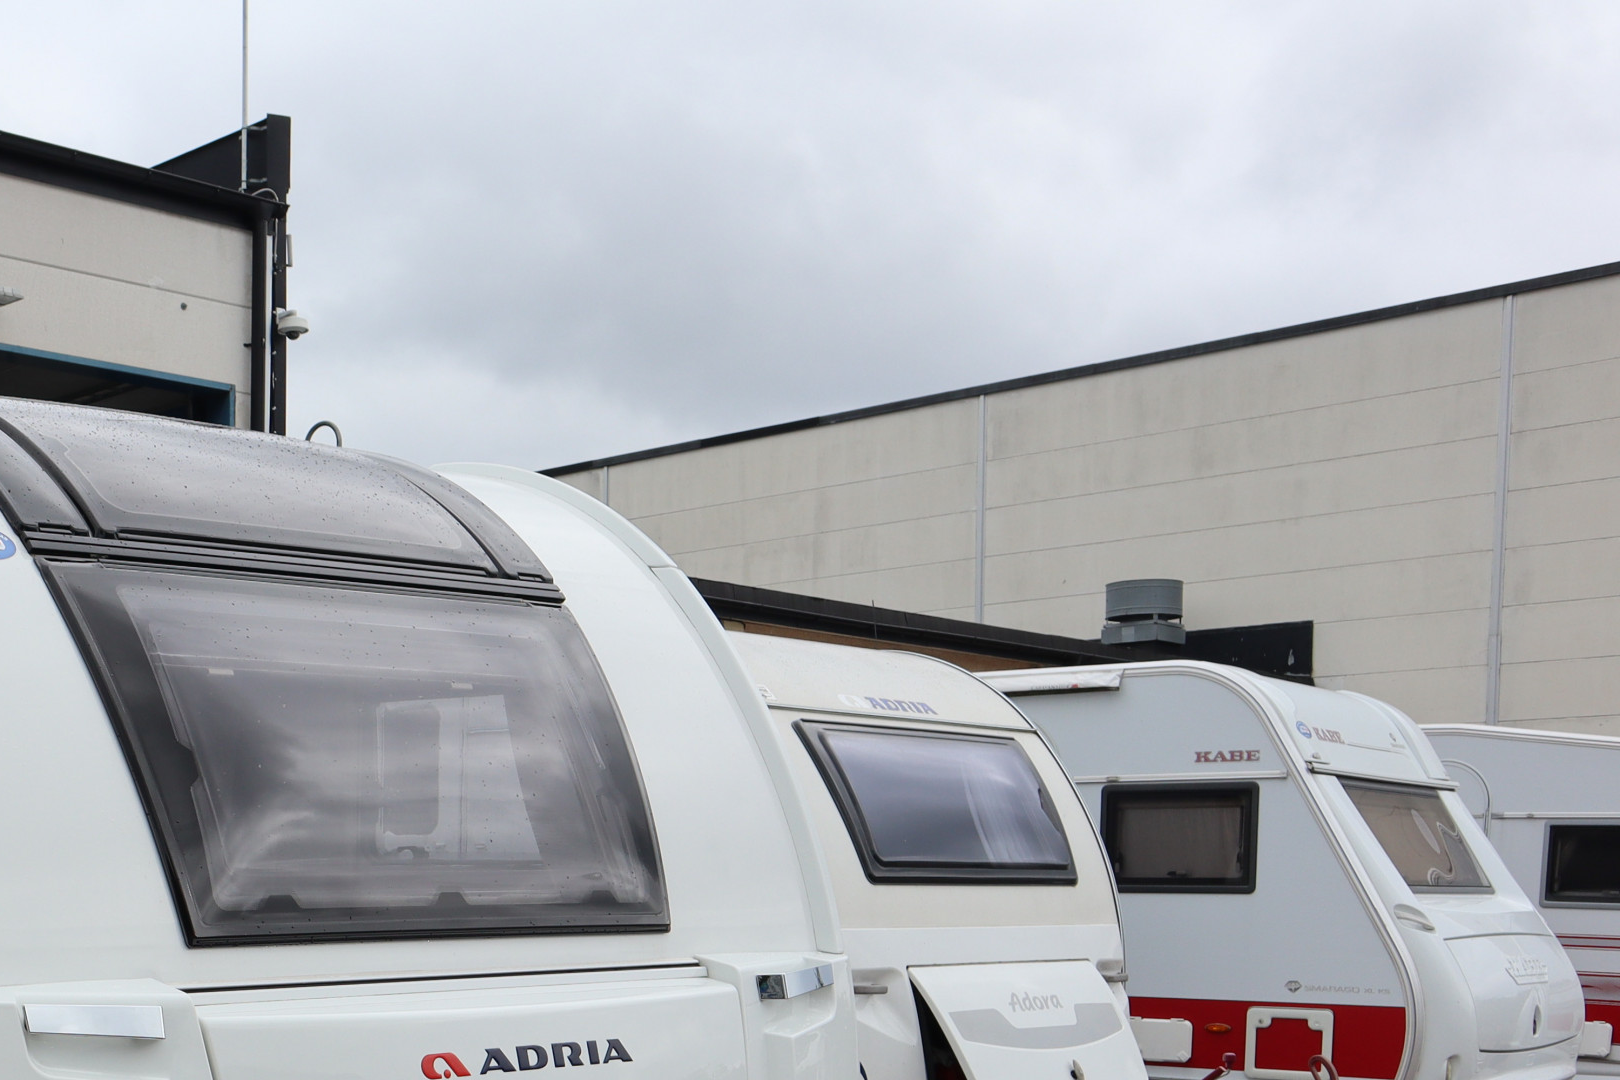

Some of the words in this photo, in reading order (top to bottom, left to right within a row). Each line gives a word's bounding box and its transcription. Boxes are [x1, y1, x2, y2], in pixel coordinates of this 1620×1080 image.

[864, 696, 939, 716] ADRIA
[1311, 726, 1346, 745] KABE
[1194, 749, 1261, 764] KABE
[1008, 991, 1064, 1013] Adora
[479, 1038, 634, 1075] ADRIA
